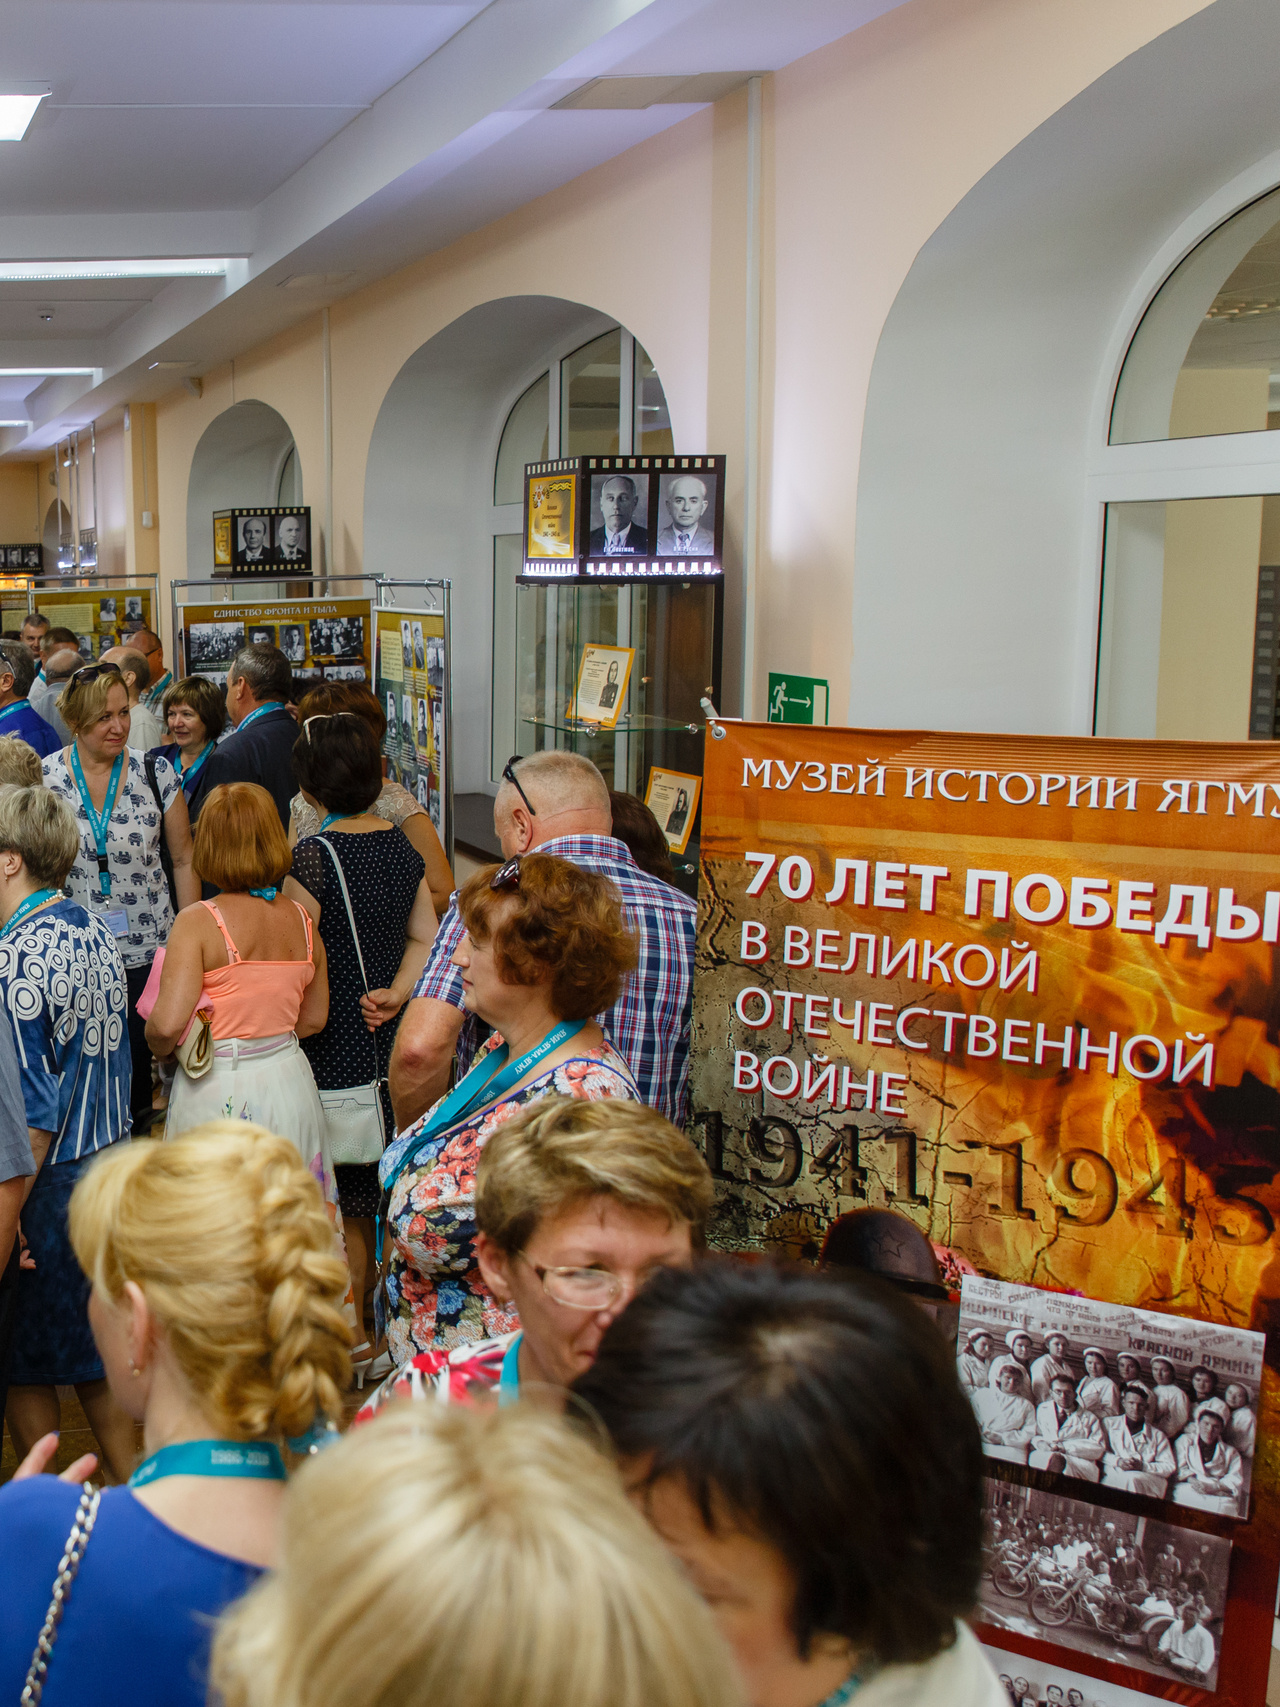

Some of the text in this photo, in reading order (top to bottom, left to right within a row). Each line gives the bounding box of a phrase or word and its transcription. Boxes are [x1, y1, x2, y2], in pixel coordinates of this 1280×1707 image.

[213, 605, 338, 618] ЕДИНСТВО ФРОНТА И ТЫЛА
[741, 756, 887, 799] МУЗЕЙ
[903, 766, 1140, 813] ИСТОРИИ
[743, 850, 1280, 949] 70 ЛЕТ ПОБЕДЫ
[739, 920, 1040, 995] В ВЕЛИКОЙ
[514, 1028, 568, 1075] ЯМИ-ЯГМА-ЯГМУ
[734, 986, 1217, 1088] ОТЕЧЕСТВЕННОЙ
[732, 1048, 910, 1117] ВОЙНЕ
[694, 1110, 1276, 1247] 1941-1945
[1128, 1335, 1194, 1363] КРАСНОЙ
[1201, 1353, 1256, 1376] АРМИИ
